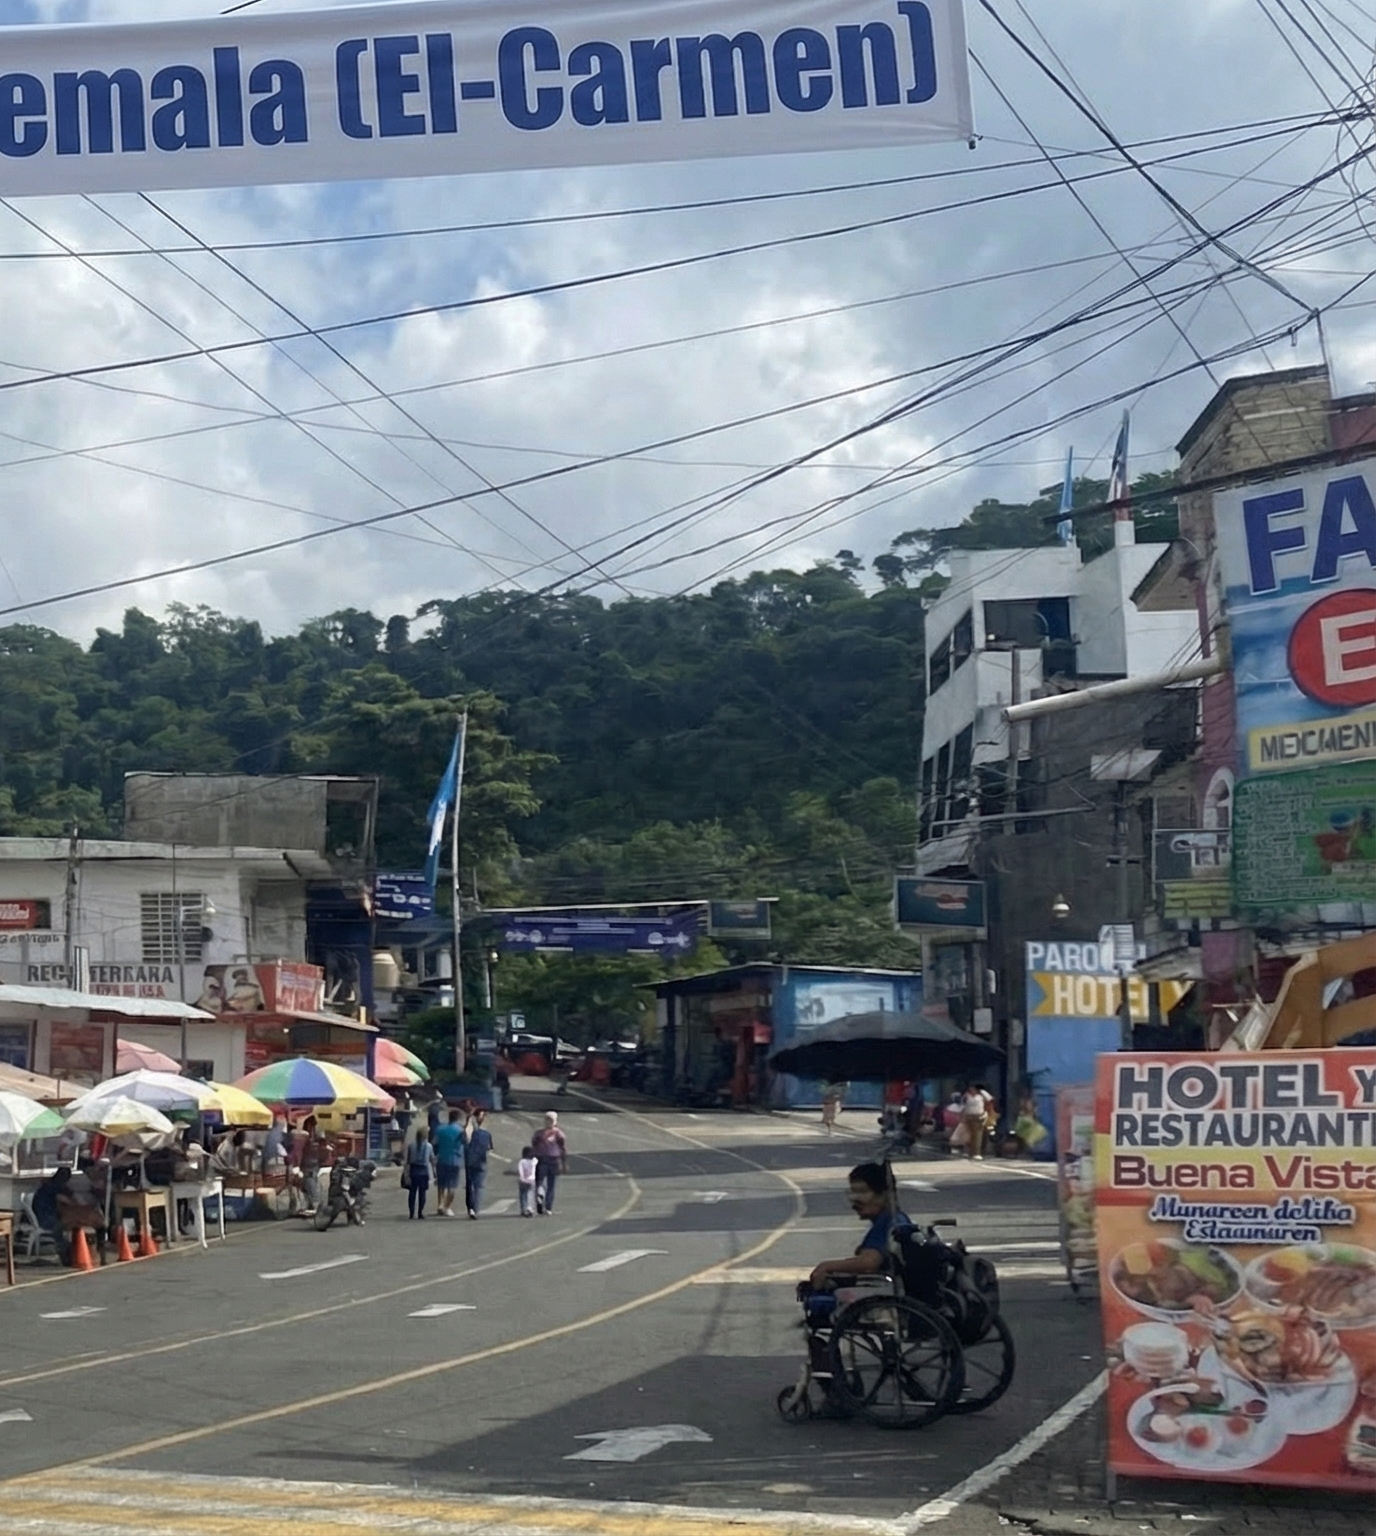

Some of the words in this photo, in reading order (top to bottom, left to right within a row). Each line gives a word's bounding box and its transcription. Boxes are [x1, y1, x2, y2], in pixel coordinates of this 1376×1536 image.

[335, 0, 939, 141] (El-Carmen)
[1118, 1063, 1340, 1110] HOTEL
[1353, 1068, 1376, 1103] Y
[1115, 1111, 1376, 1148] RESTAURANT
[1113, 1154, 1255, 1189] Buena
